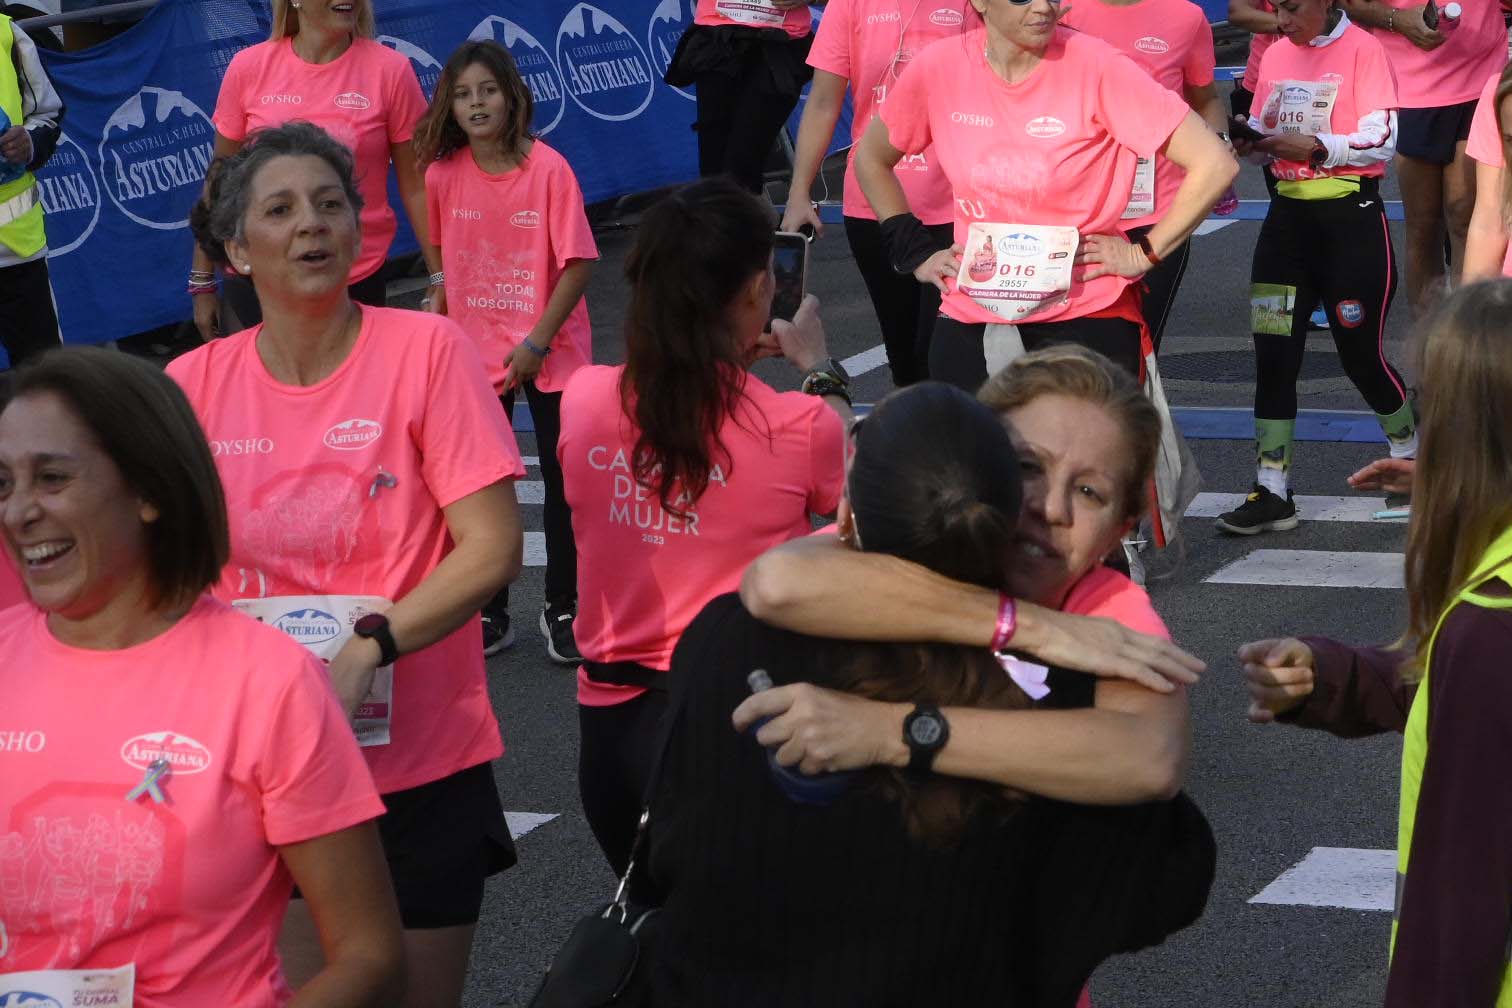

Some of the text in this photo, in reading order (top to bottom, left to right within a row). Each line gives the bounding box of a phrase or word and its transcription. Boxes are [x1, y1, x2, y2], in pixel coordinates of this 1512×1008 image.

[567, 48, 650, 96] ASTURIANA
[261, 95, 302, 105] OYSHO
[951, 111, 994, 128] OYSHO
[1279, 111, 1304, 123] 016
[452, 208, 481, 220] YSHO
[999, 264, 1036, 277] 016
[1000, 279, 1027, 288] 29557
[467, 297, 535, 313] NOSOTRAS
[609, 501, 700, 536] MUJER
[641, 533, 665, 545] 2023
